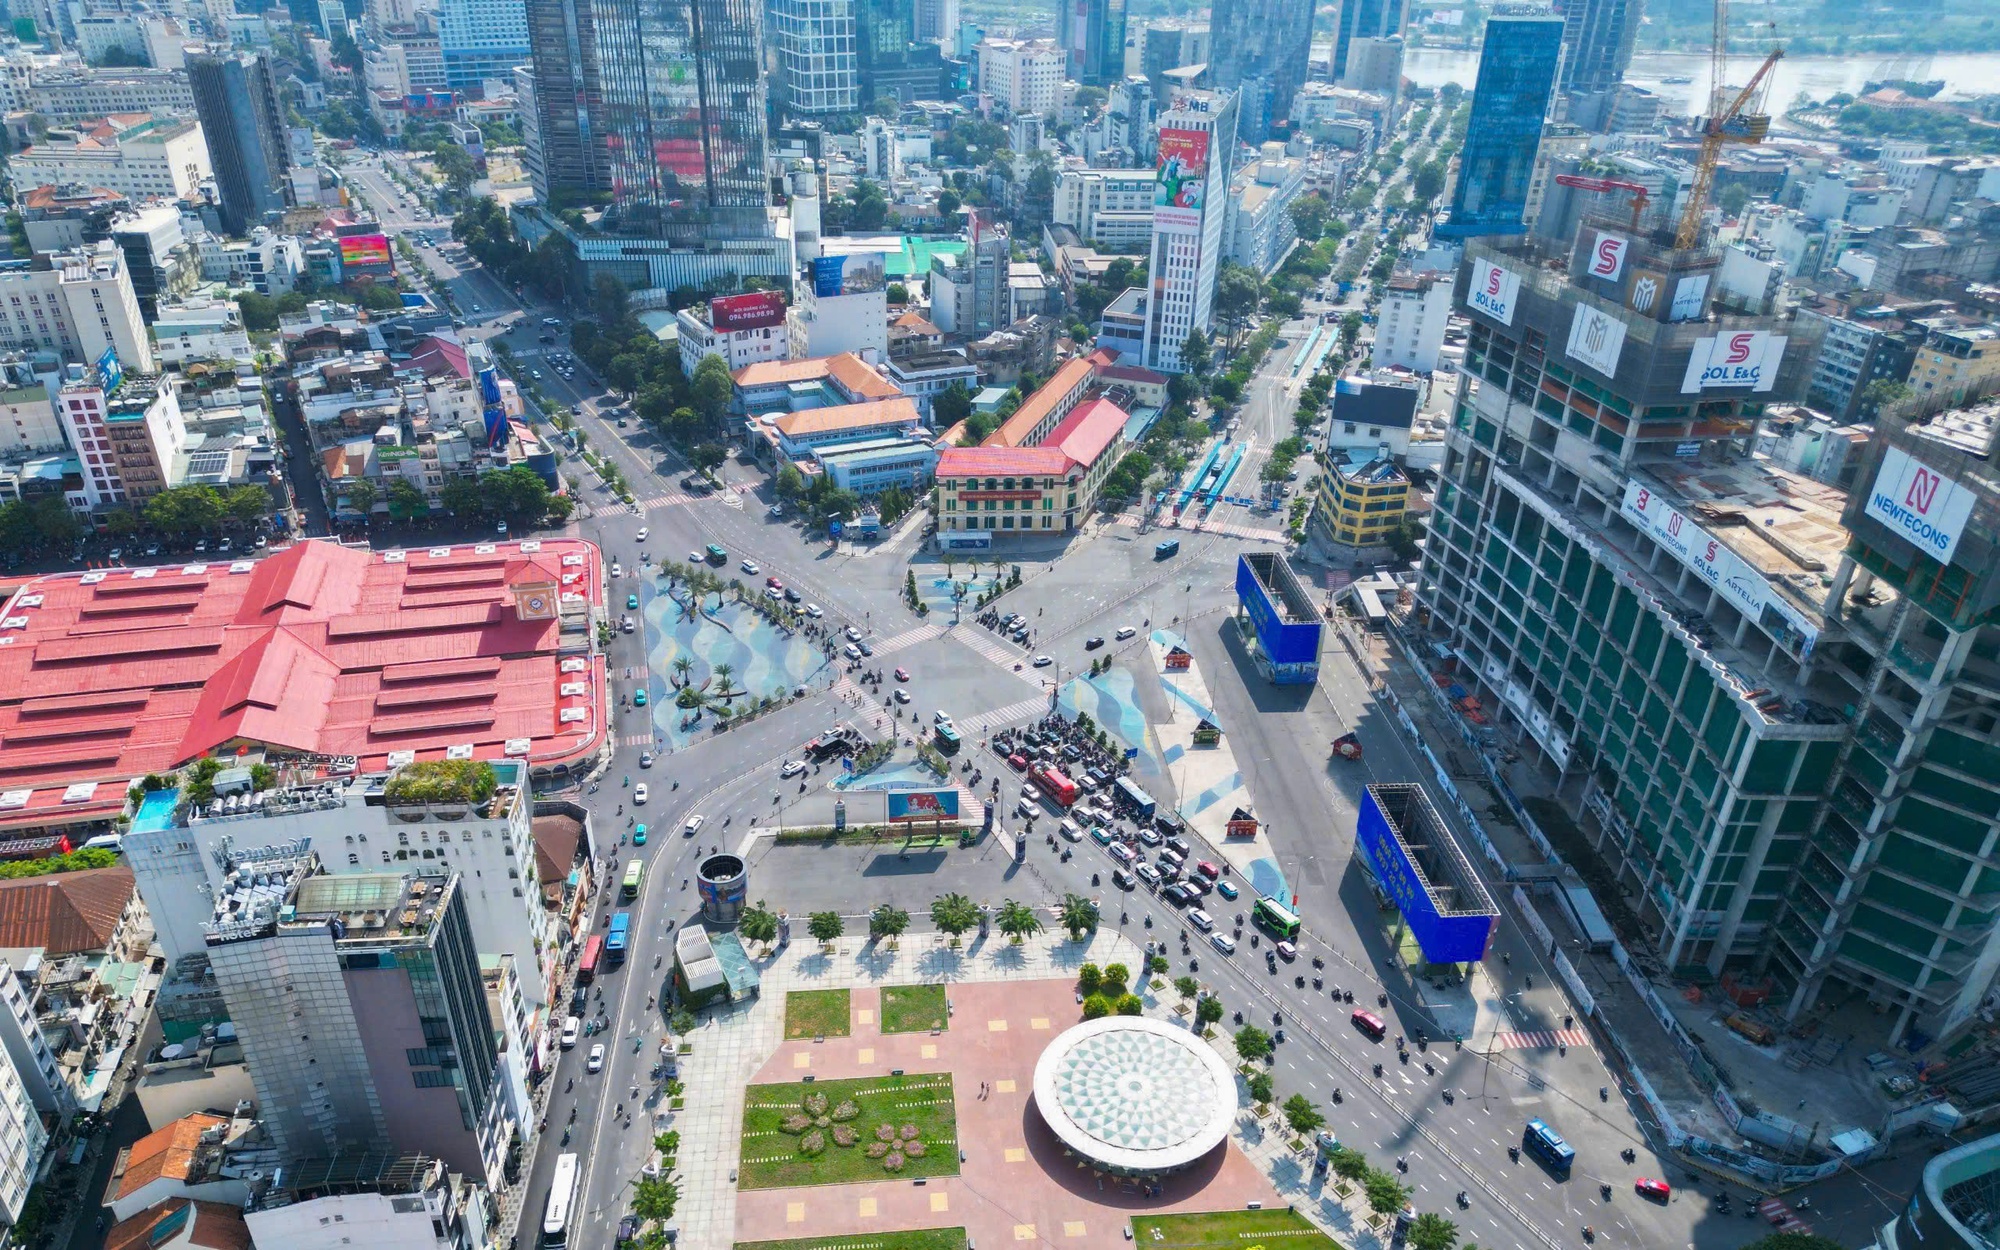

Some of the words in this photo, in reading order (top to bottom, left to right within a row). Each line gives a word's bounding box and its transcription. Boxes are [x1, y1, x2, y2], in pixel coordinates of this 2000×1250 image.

[1189, 100, 1209, 112] MB
[1475, 291, 1490, 308] SOL
[1701, 366, 1729, 381] SOL
[1733, 366, 1761, 380] E&C
[1873, 493, 1949, 550] NEWTECONS
[1653, 524, 1688, 556] NEWTECONS
[1693, 555, 1706, 572] SOL
[1724, 577, 1761, 612] ARTELIA
